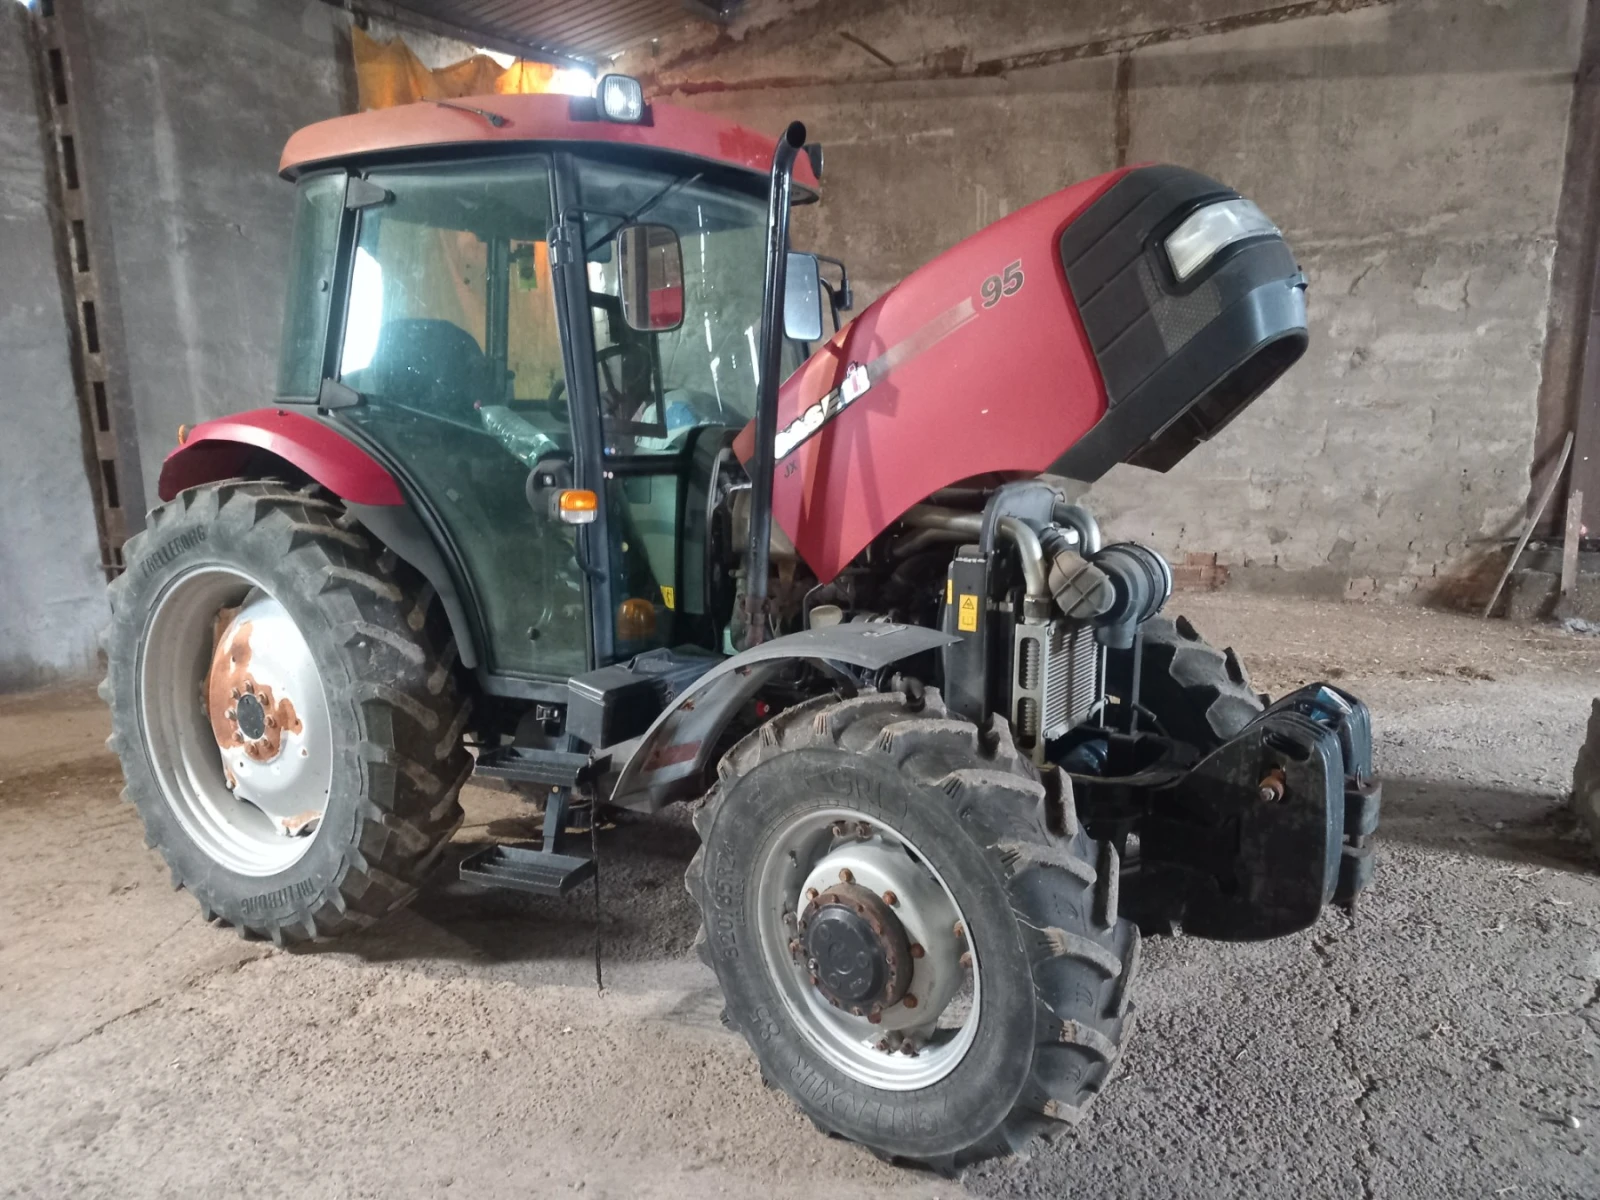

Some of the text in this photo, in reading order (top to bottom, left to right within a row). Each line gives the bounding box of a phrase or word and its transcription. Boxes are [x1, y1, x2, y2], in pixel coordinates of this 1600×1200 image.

[980, 259, 1025, 308] 95
[783, 460, 799, 479] JX
[139, 523, 208, 579] TRELLEBORG
[750, 1005, 781, 1041] 85
[790, 1056, 846, 1115] XLR
